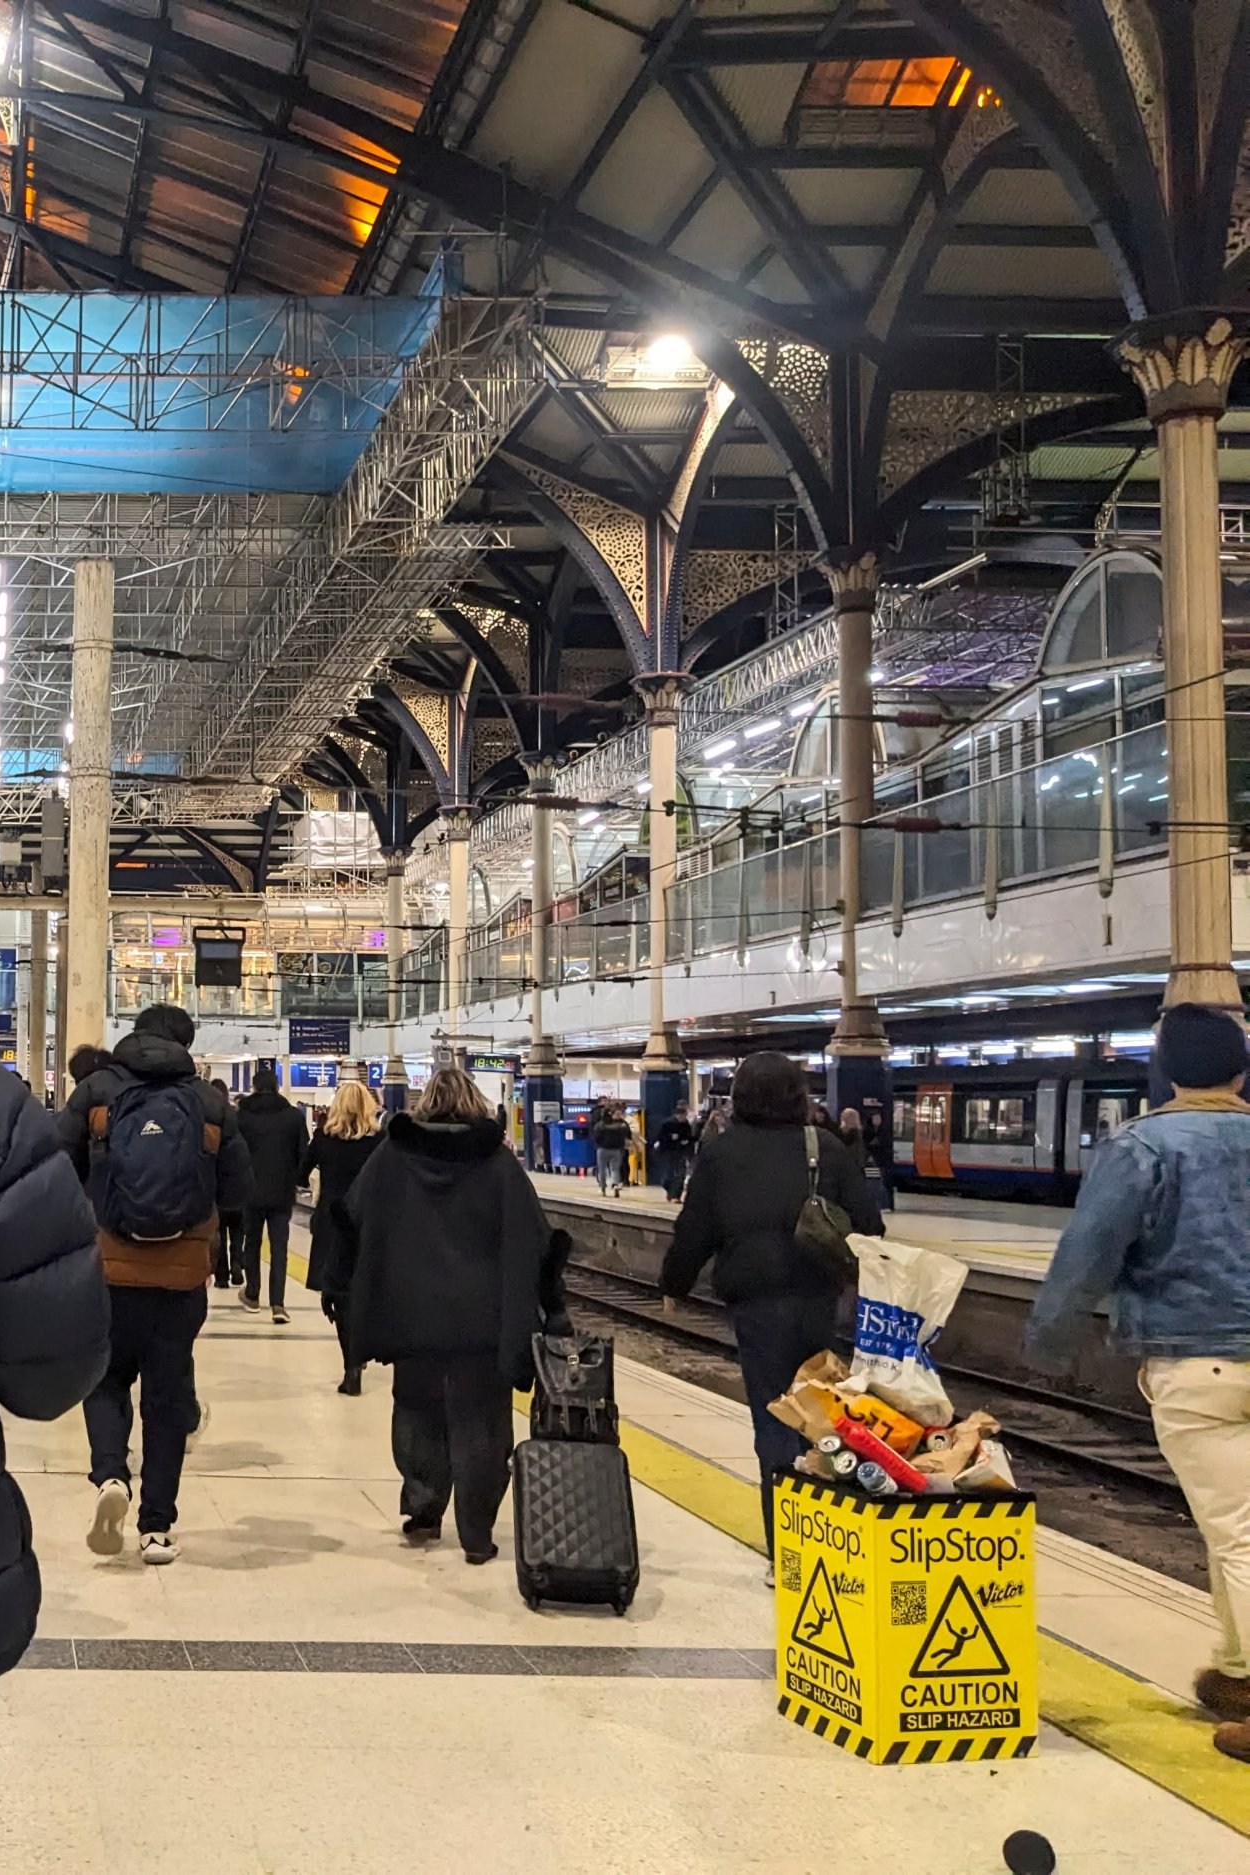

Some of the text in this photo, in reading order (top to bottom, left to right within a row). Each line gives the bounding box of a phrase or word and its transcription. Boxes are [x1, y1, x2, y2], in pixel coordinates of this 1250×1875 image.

[371, 1067, 380, 1079] 2
[831, 1571, 865, 1595] Victor
[976, 1581, 1024, 1607] Victor
[786, 1646, 861, 1701] CAUTION
[790, 1675, 858, 1720] SLIP HAZARD
[900, 1681, 1019, 1708] CAUTION
[906, 1711, 1014, 1730] SLIP HAZARD
